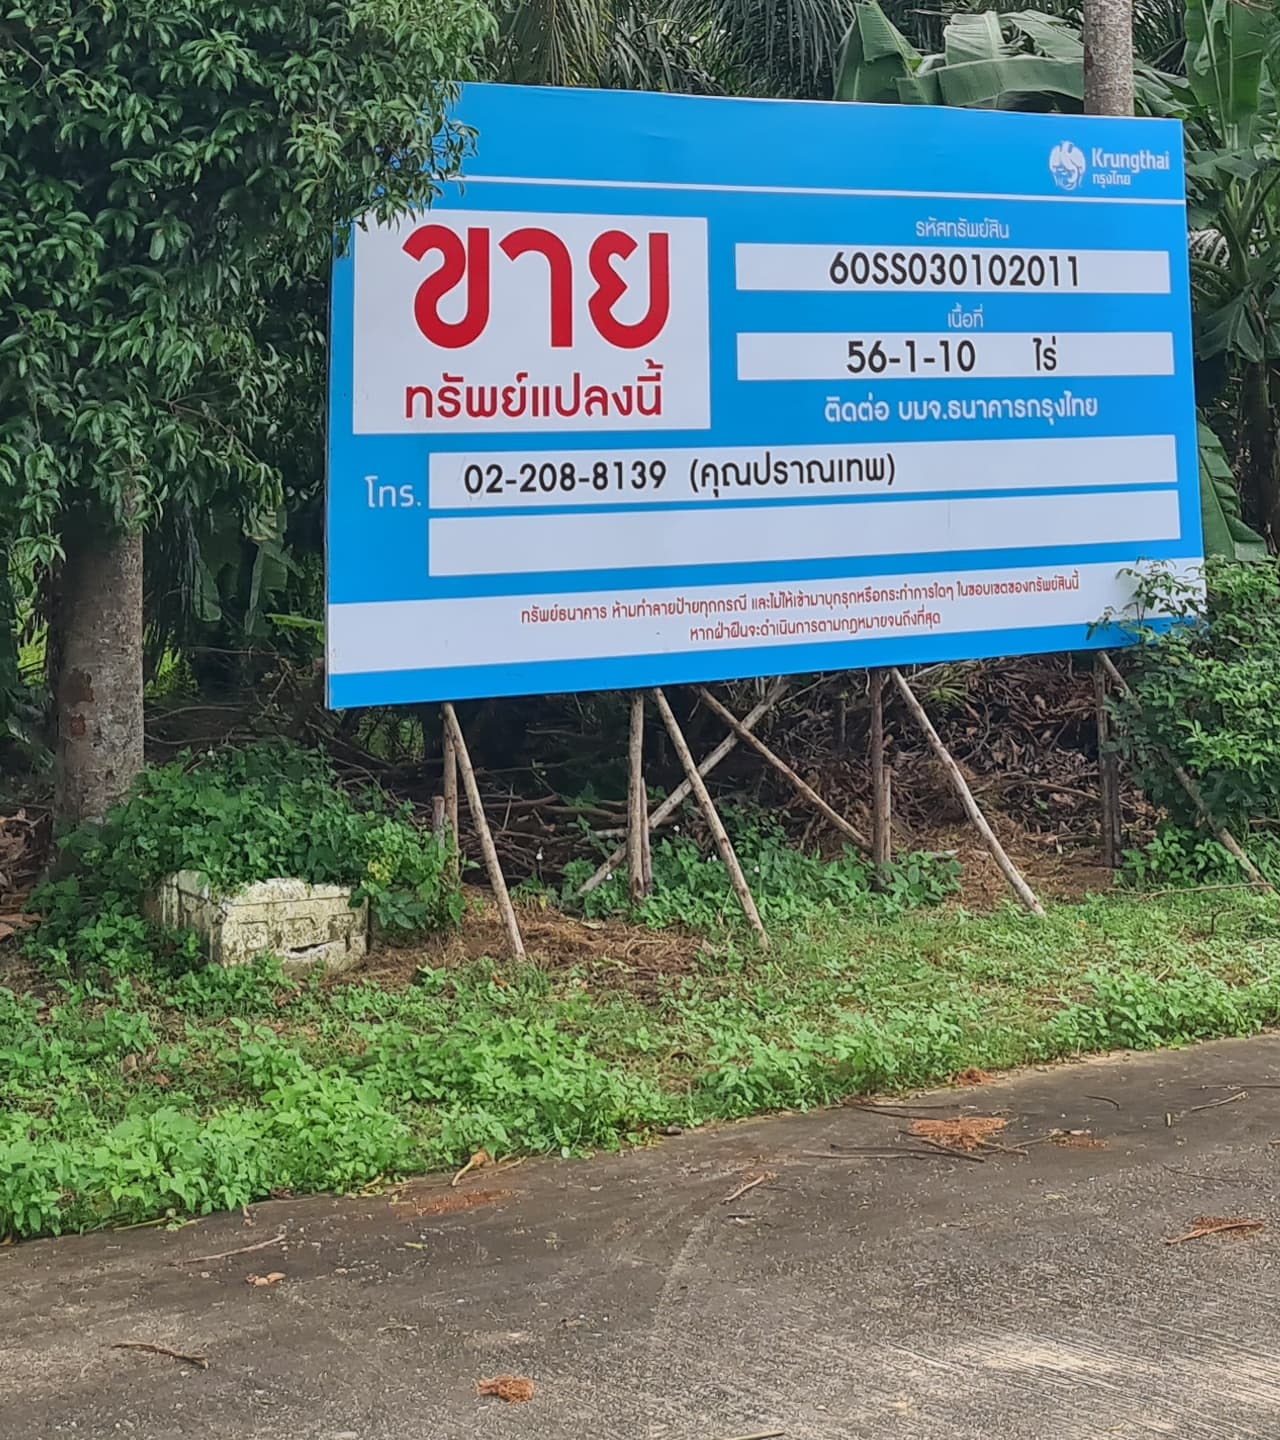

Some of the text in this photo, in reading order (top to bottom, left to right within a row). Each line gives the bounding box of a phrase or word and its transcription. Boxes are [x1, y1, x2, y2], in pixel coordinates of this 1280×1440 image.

[1091, 148, 1170, 173] Krungthai
[1092, 171, 1131, 189] กรุงไทย
[915, 216, 1009, 239] รหัสทรัพย์สิน
[402, 224, 670, 349] ขาย
[829, 252, 1078, 286] 60SS030102011
[947, 302, 984, 328] เนื้อที่
[846, 336, 1057, 373] 56-1-10 ไร่
[405, 358, 664, 418] ทรัพย์แปลงนี้
[824, 390, 1099, 426] ติดต่อ บมจ.ธนาคารกรุงไทย
[365, 452, 896, 508] โทร. 02-208-8139 (คุณปราณเทพ)
